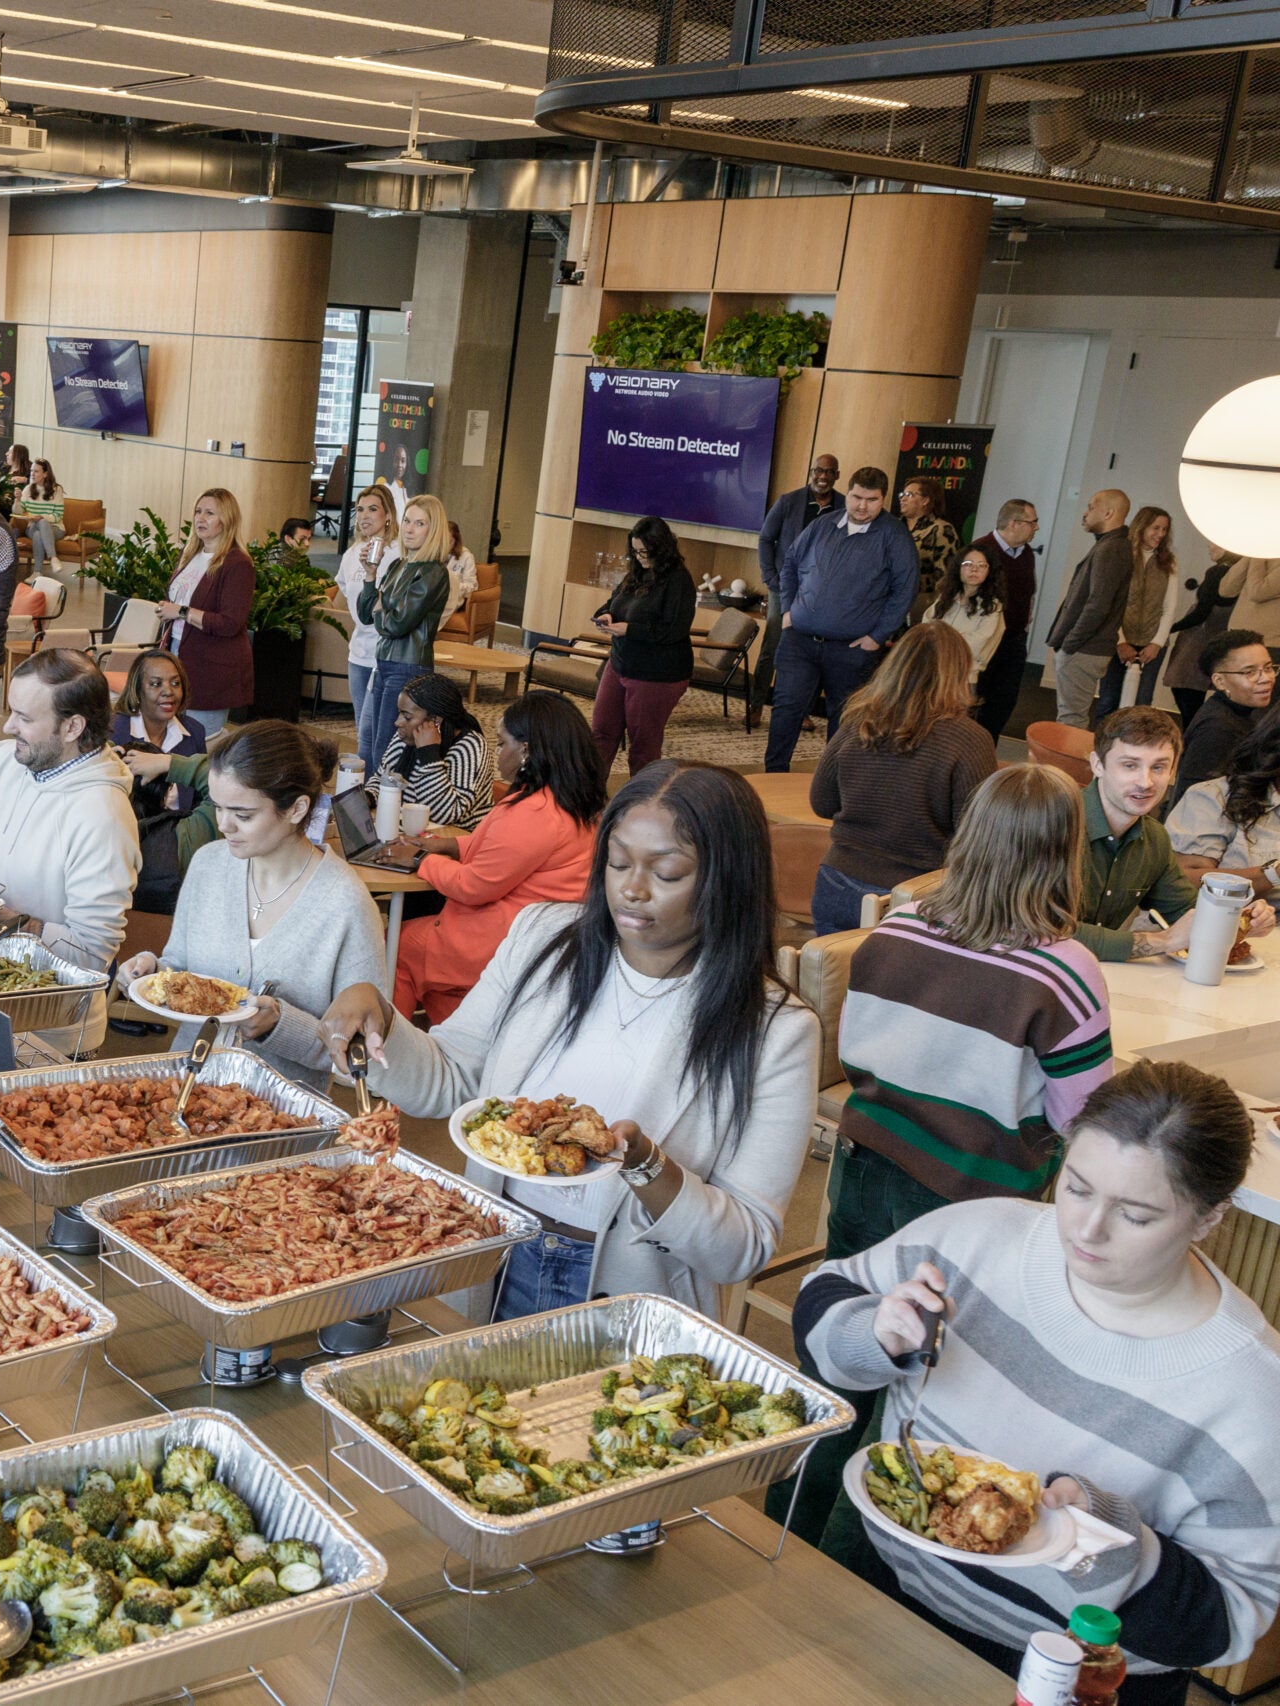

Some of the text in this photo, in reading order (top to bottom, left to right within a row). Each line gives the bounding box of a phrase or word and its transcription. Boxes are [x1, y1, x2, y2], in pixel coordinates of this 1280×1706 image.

[64, 375, 128, 390] No Stream Detected
[390, 394, 420, 402] CELEBRATING
[615, 388, 637, 396] NETWORK
[389, 417, 416, 430] CORBETT
[607, 429, 740, 457] No Stream Detected
[922, 442, 972, 450] CELEBRATING
[916, 455, 974, 470] THASUNDA
